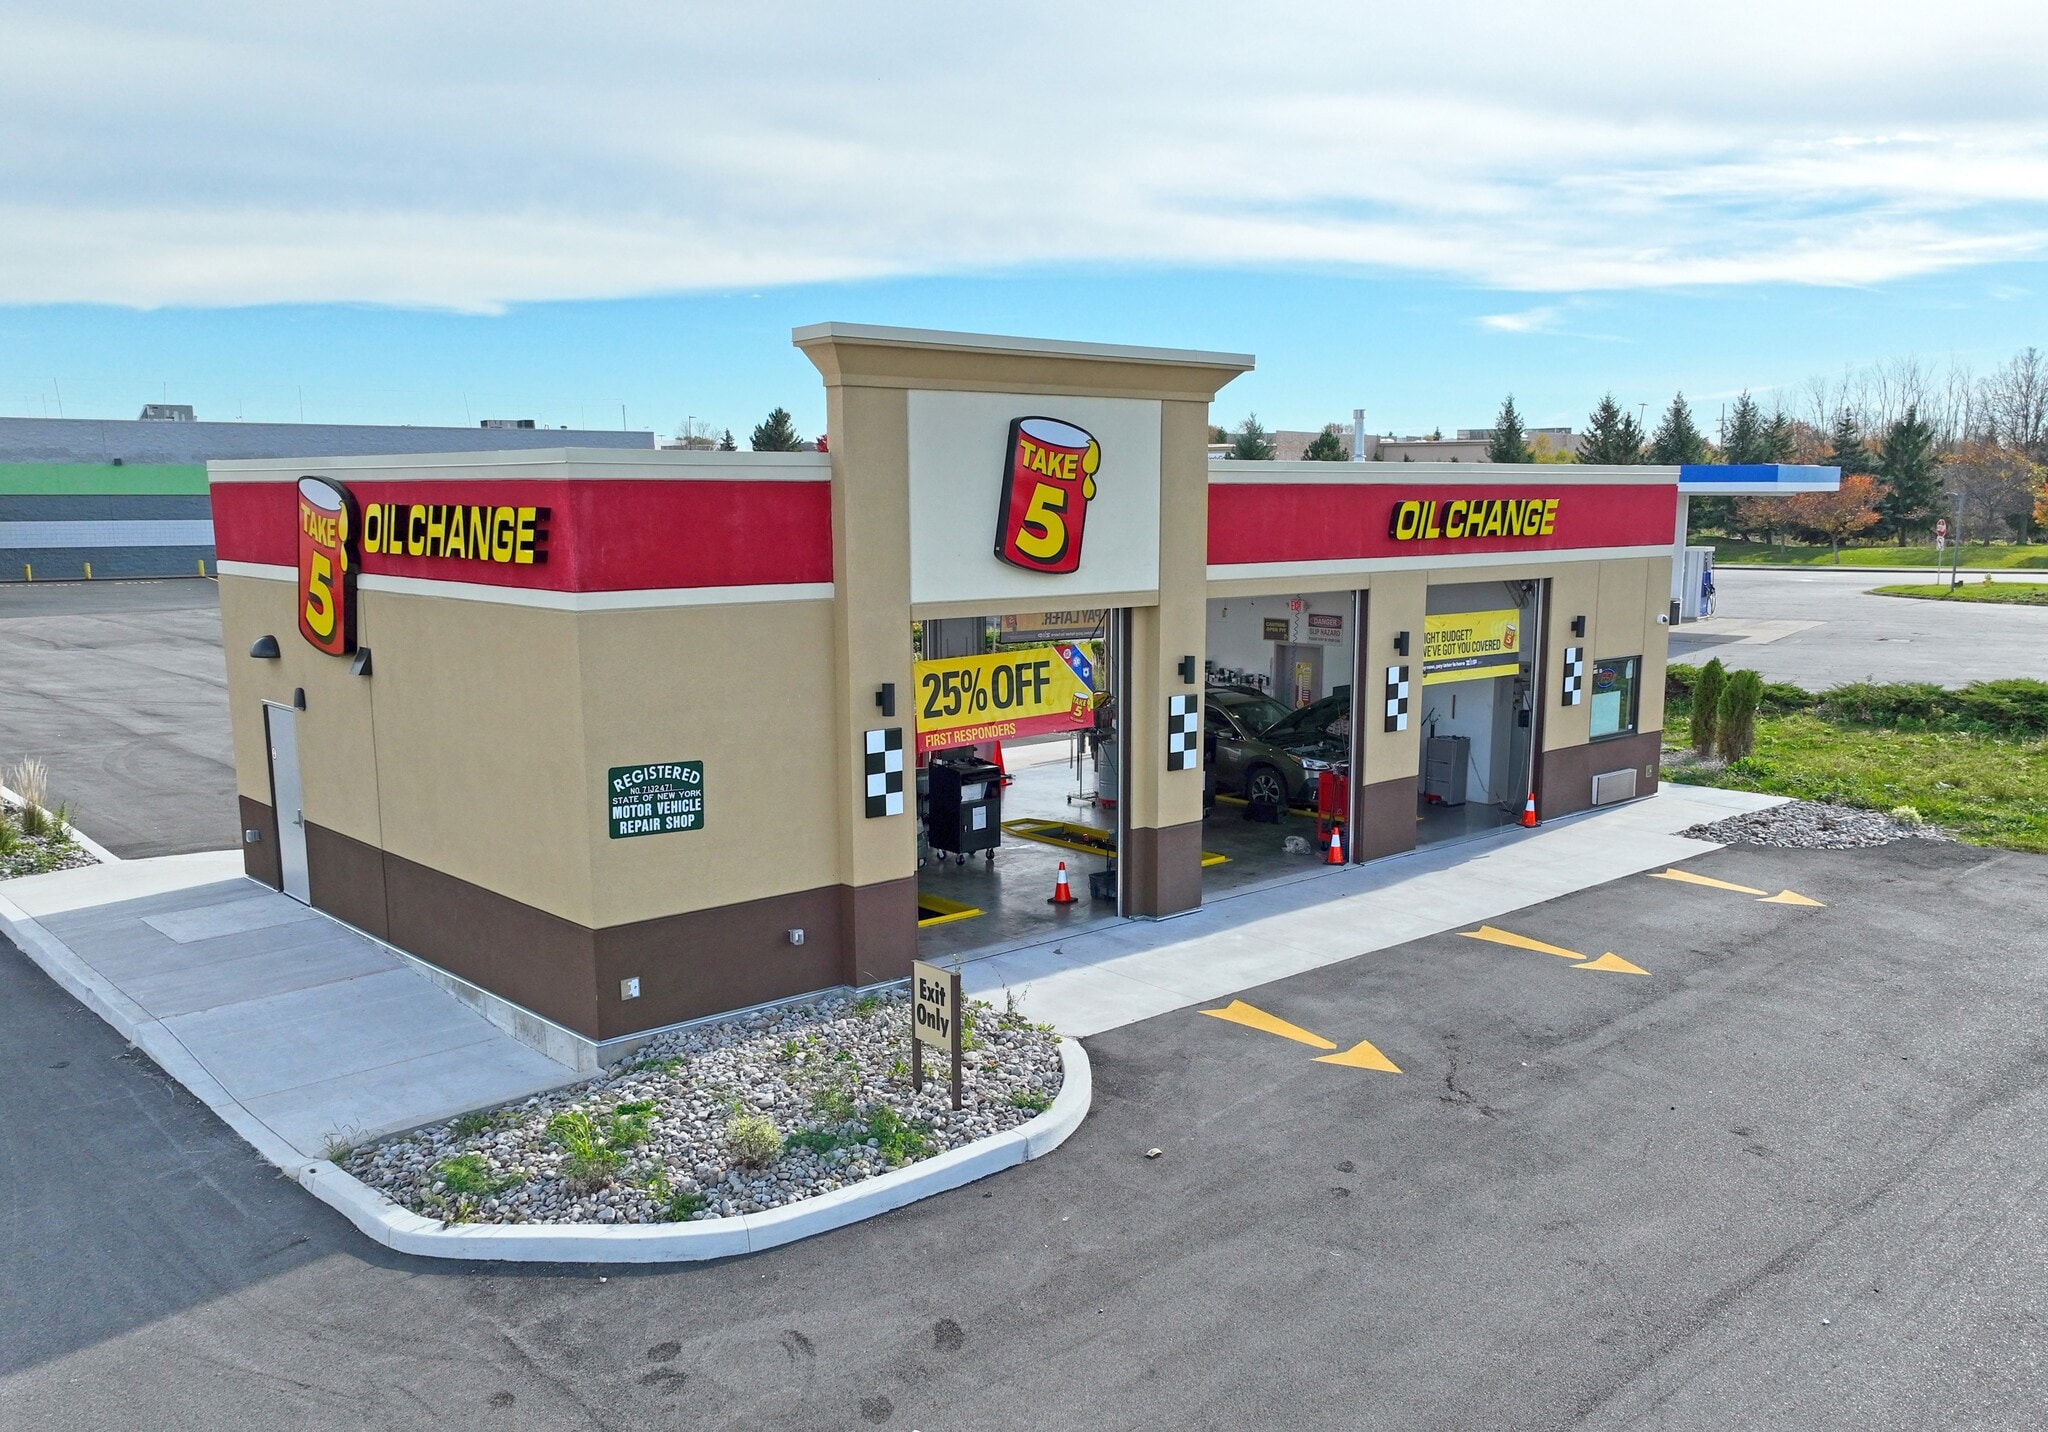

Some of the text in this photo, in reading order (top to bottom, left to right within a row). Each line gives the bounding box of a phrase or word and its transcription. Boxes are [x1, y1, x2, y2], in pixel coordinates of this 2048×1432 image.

[1020, 439, 1079, 480] TAKE
[301, 502, 336, 548] TAKE
[364, 503, 540, 564] OIL CHANGE
[1014, 482, 1066, 560] 5
[1395, 499, 1560, 540] OIL CHANGE
[305, 551, 335, 638] 5
[1313, 618, 1337, 626] DANGER
[1423, 629, 1473, 644] IGHT BUDGET?
[1442, 643, 1456, 655] GOT
[1457, 641, 1471, 654] YOU
[1472, 639, 1501, 652] COVERED
[922, 660, 1050, 719] 25% OFF
[1073, 706, 1083, 717] 5
[925, 722, 1016, 748] FIRST RESPONDERS
[613, 765, 701, 793] REGISTERED
[612, 789, 702, 805] STATE OF NEW YORK
[612, 798, 702, 820] MOTOR VEHICLE
[619, 814, 695, 835] REPAIR SHOP
[919, 977, 946, 1006] Exit
[916, 1003, 949, 1038] Only
